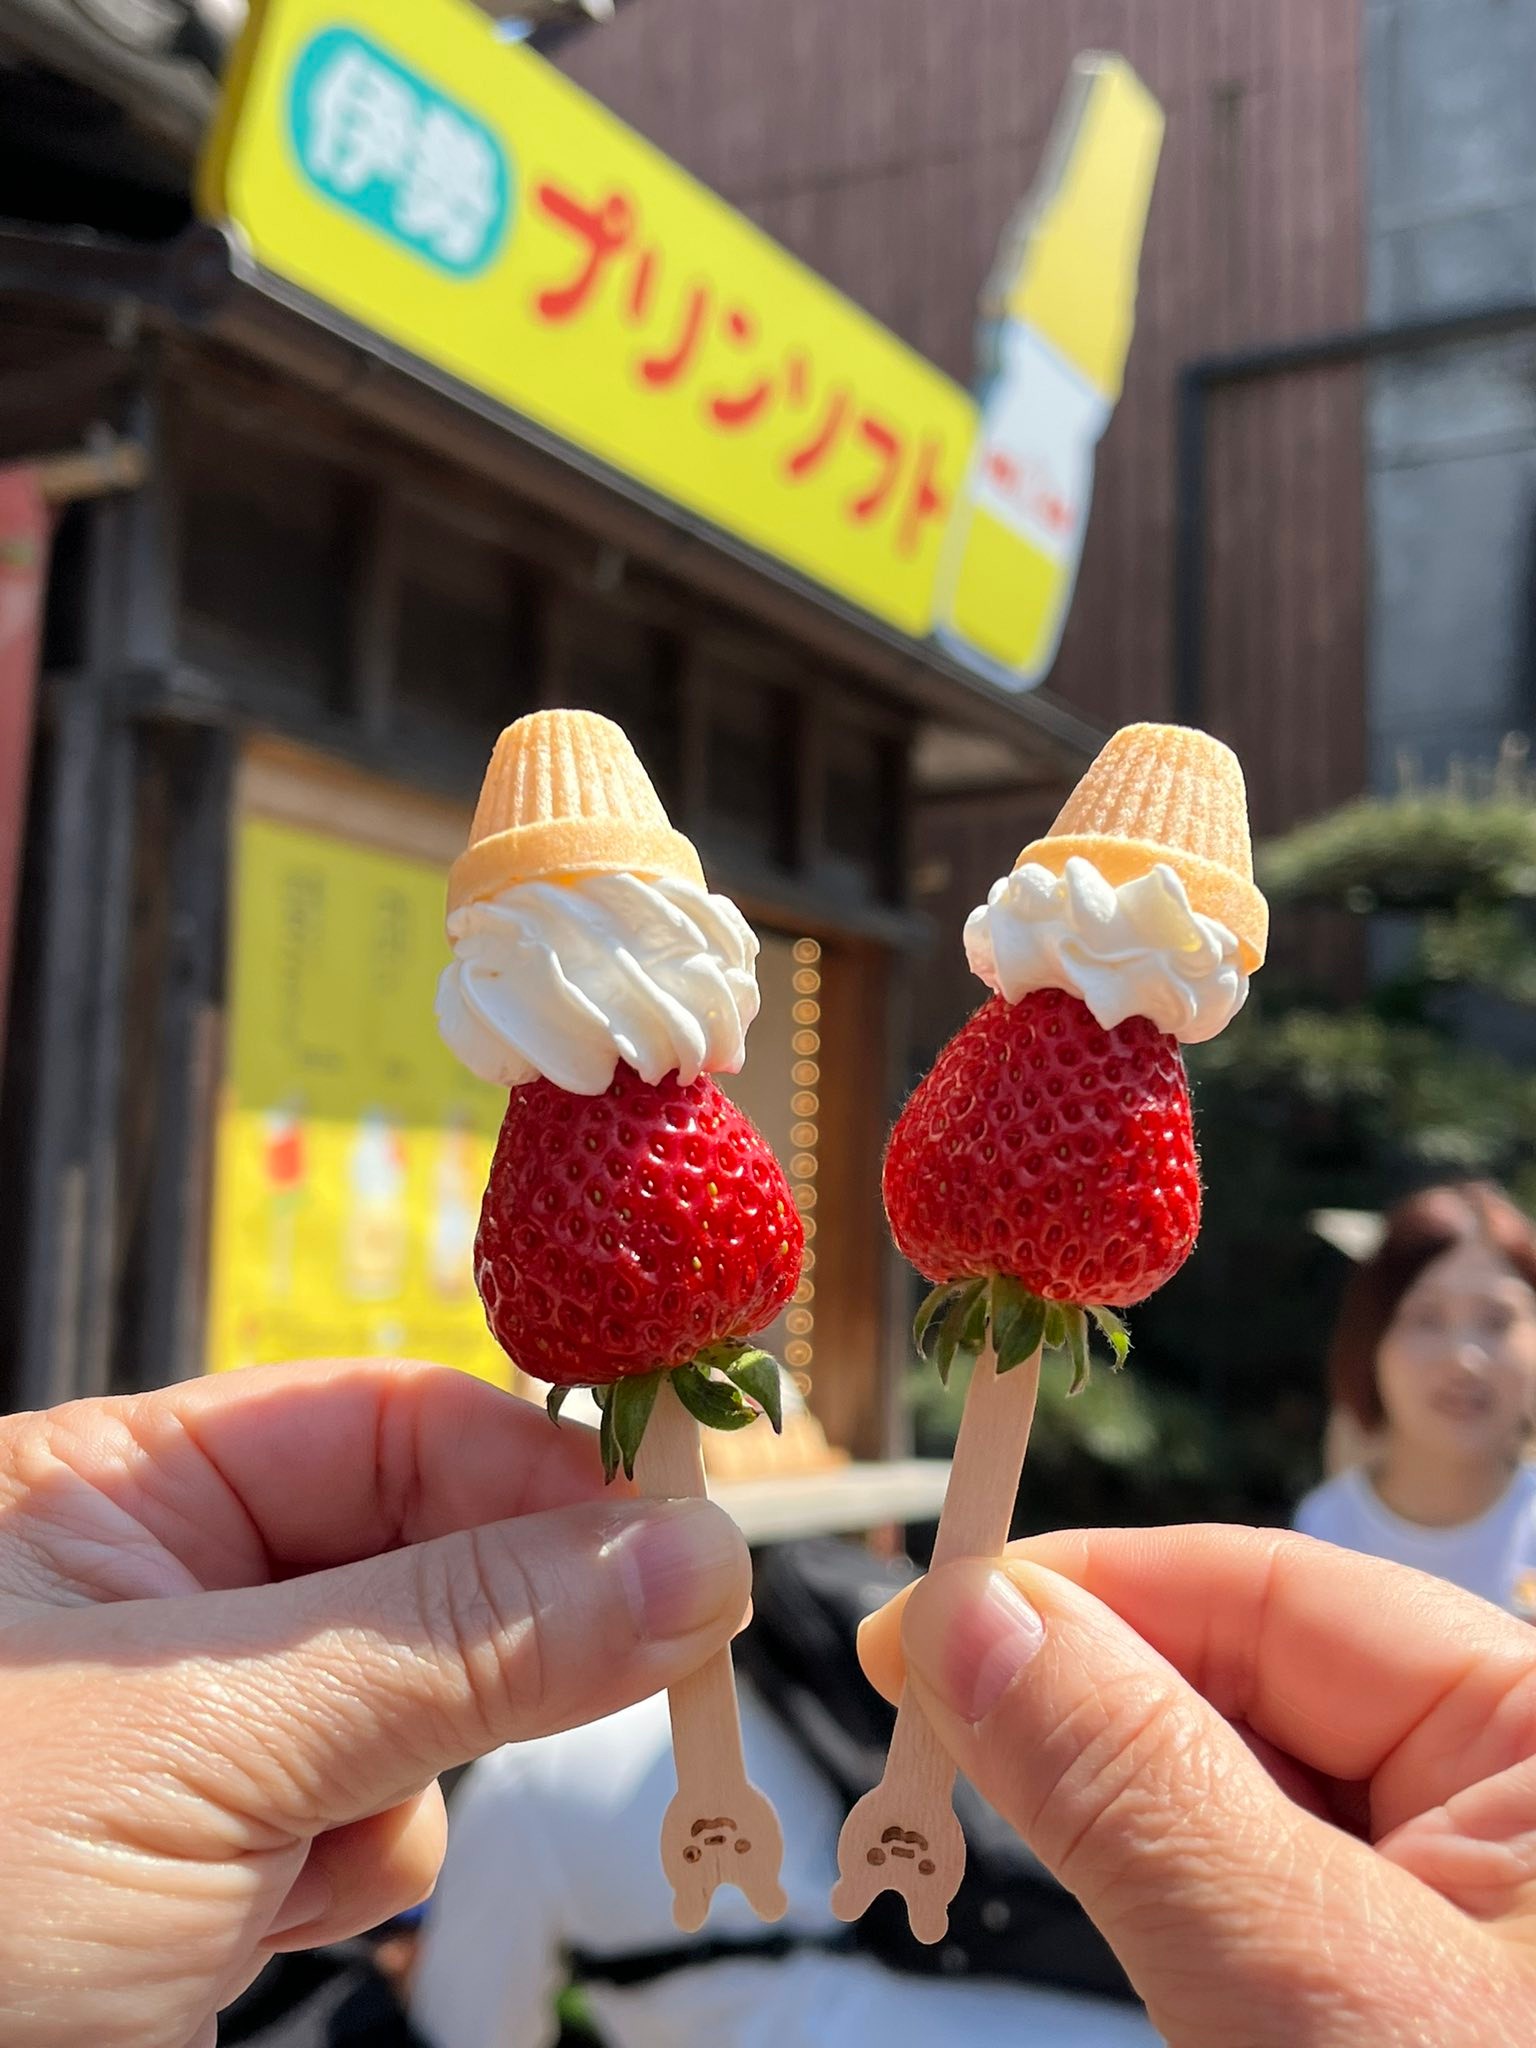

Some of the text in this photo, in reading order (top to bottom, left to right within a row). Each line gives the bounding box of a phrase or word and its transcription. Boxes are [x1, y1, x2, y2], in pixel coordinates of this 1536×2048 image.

[534, 180, 947, 556] プリンソフト
